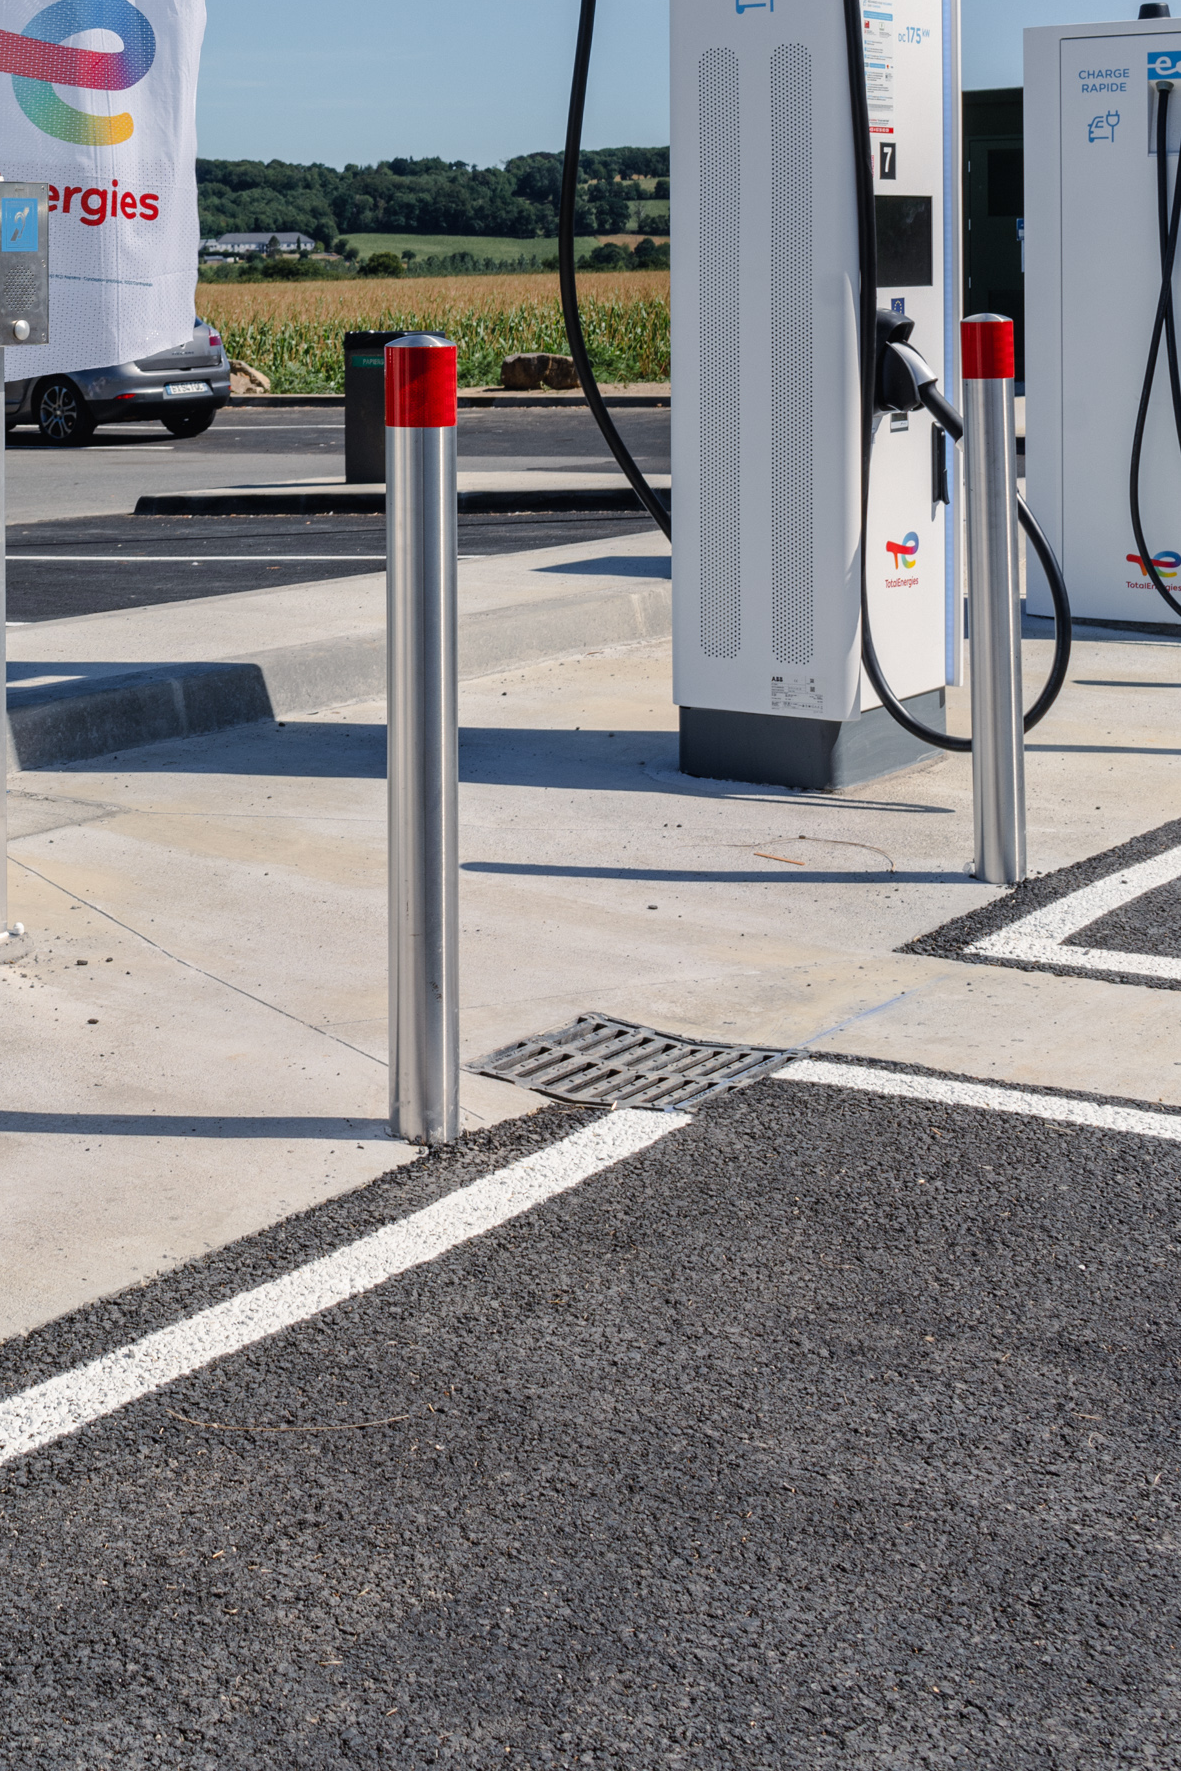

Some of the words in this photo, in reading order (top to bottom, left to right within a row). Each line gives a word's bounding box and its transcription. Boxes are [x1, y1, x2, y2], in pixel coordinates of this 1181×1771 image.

[898, 32, 906, 43] DC
[906, 26, 922, 44] 175
[922, 28, 931, 39] kW
[1078, 68, 1130, 80] CHARGE
[1081, 82, 1127, 93] RAPIDE
[883, 146, 893, 173] 7
[885, 576, 919, 588] TotalEnergies
[1126, 581, 1181, 592] TotalEngies
